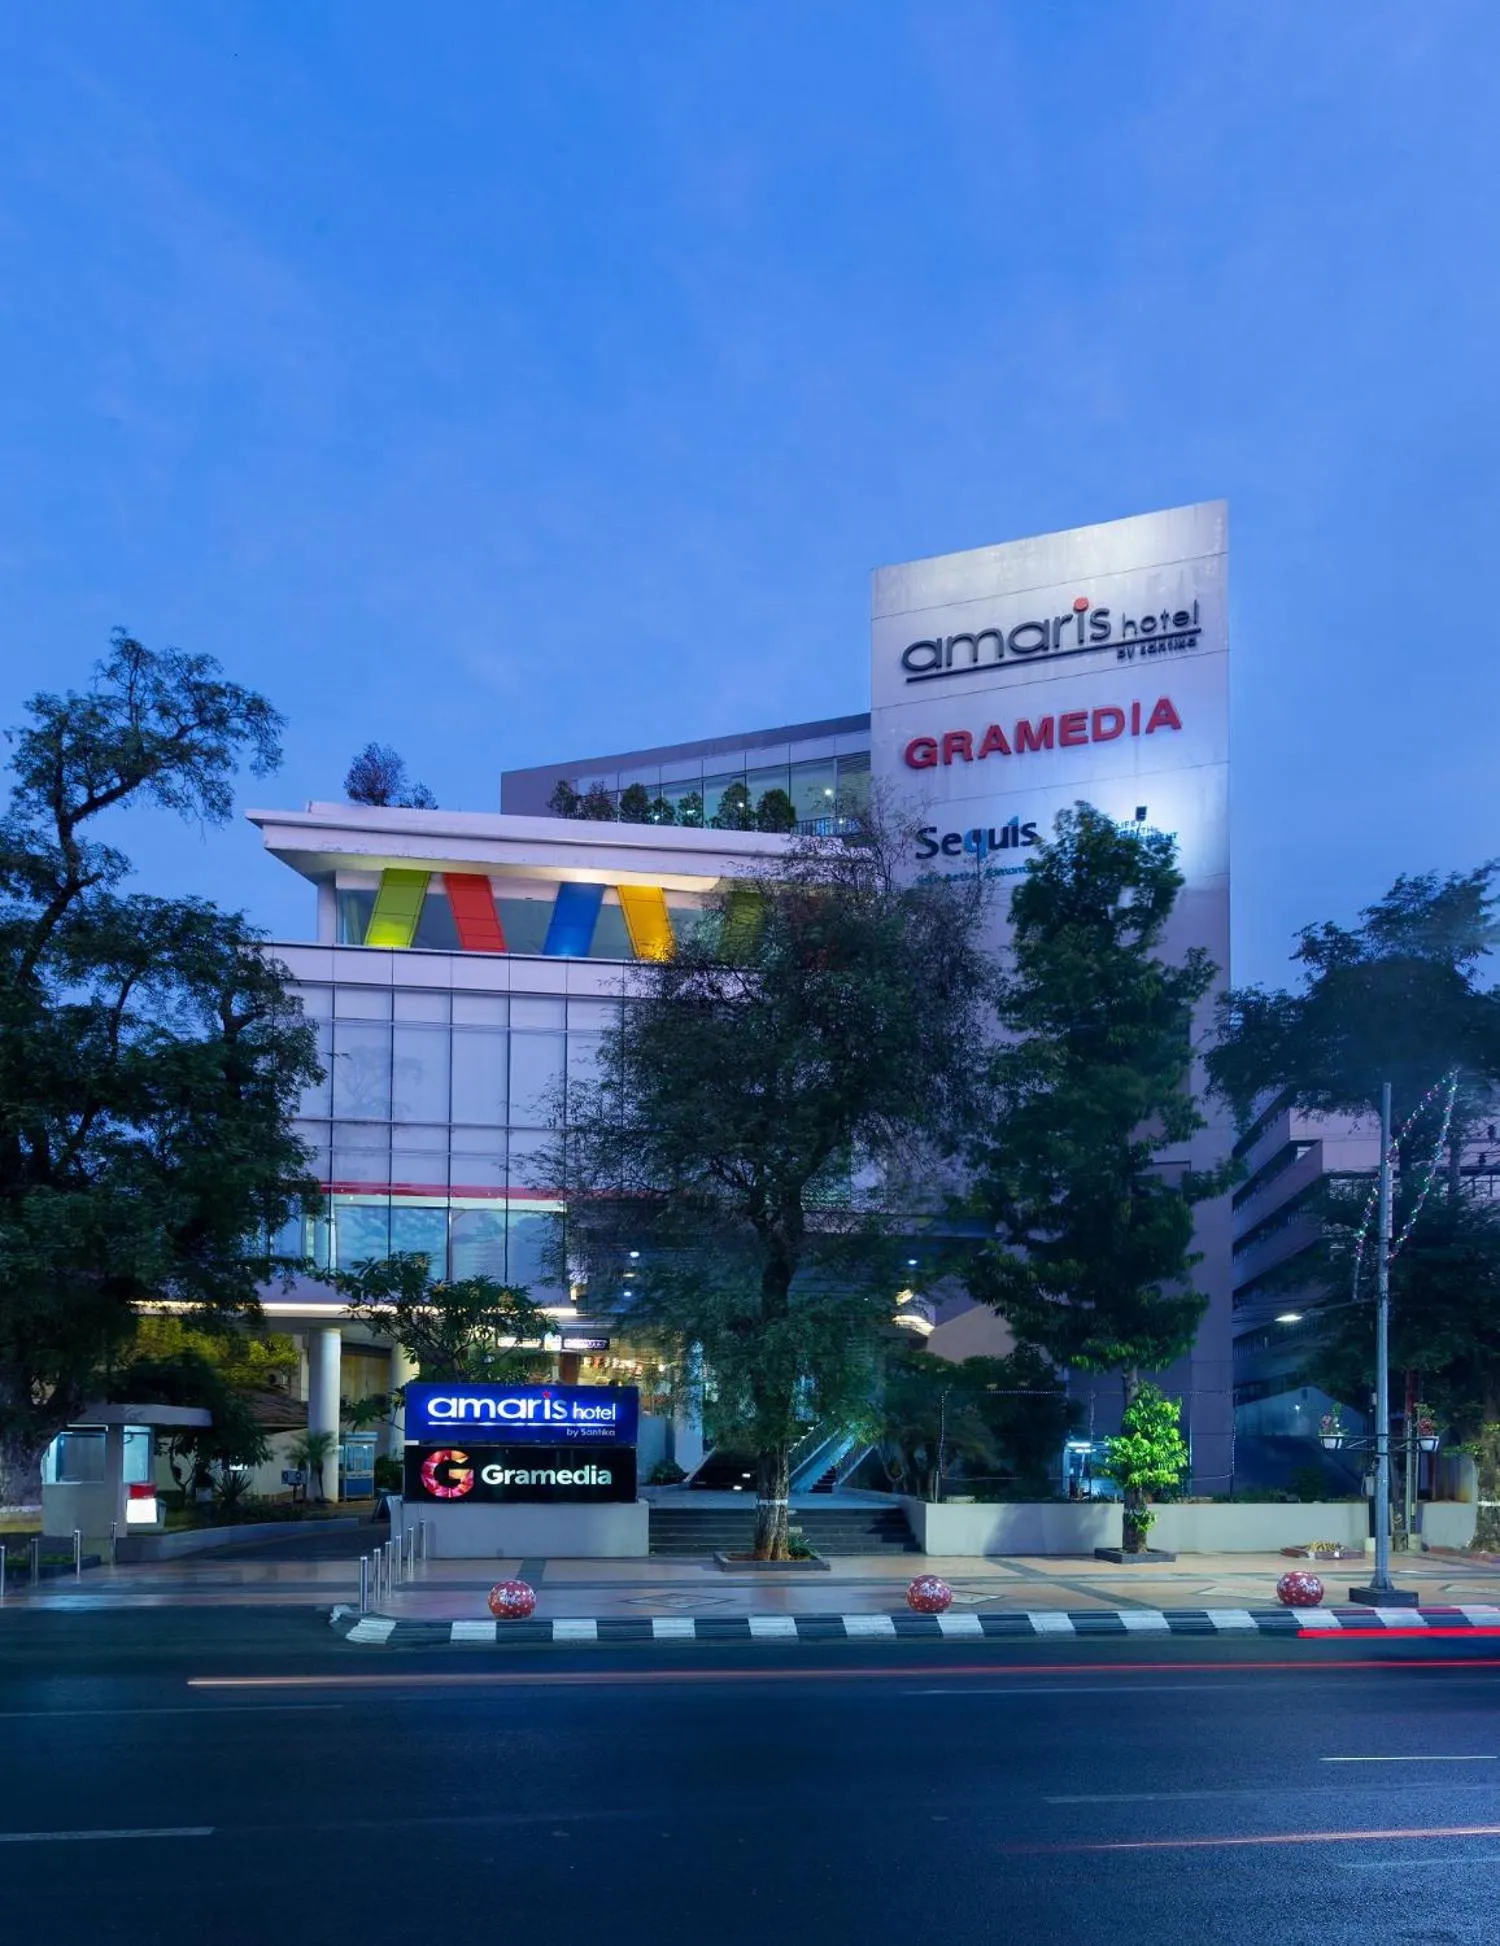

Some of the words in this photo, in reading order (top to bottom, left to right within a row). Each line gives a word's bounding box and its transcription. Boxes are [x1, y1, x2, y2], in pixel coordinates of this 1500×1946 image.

[902, 597, 1112, 672] amaris
[1122, 599, 1199, 639] hotel
[905, 697, 1182, 769] GRAMEDIA
[915, 815, 1038, 861] Sequis
[427, 1391, 568, 1420] amaris
[572, 1403, 616, 1421] hotel
[566, 1428, 579, 1438] by
[481, 1463, 612, 1485] Gramedia
